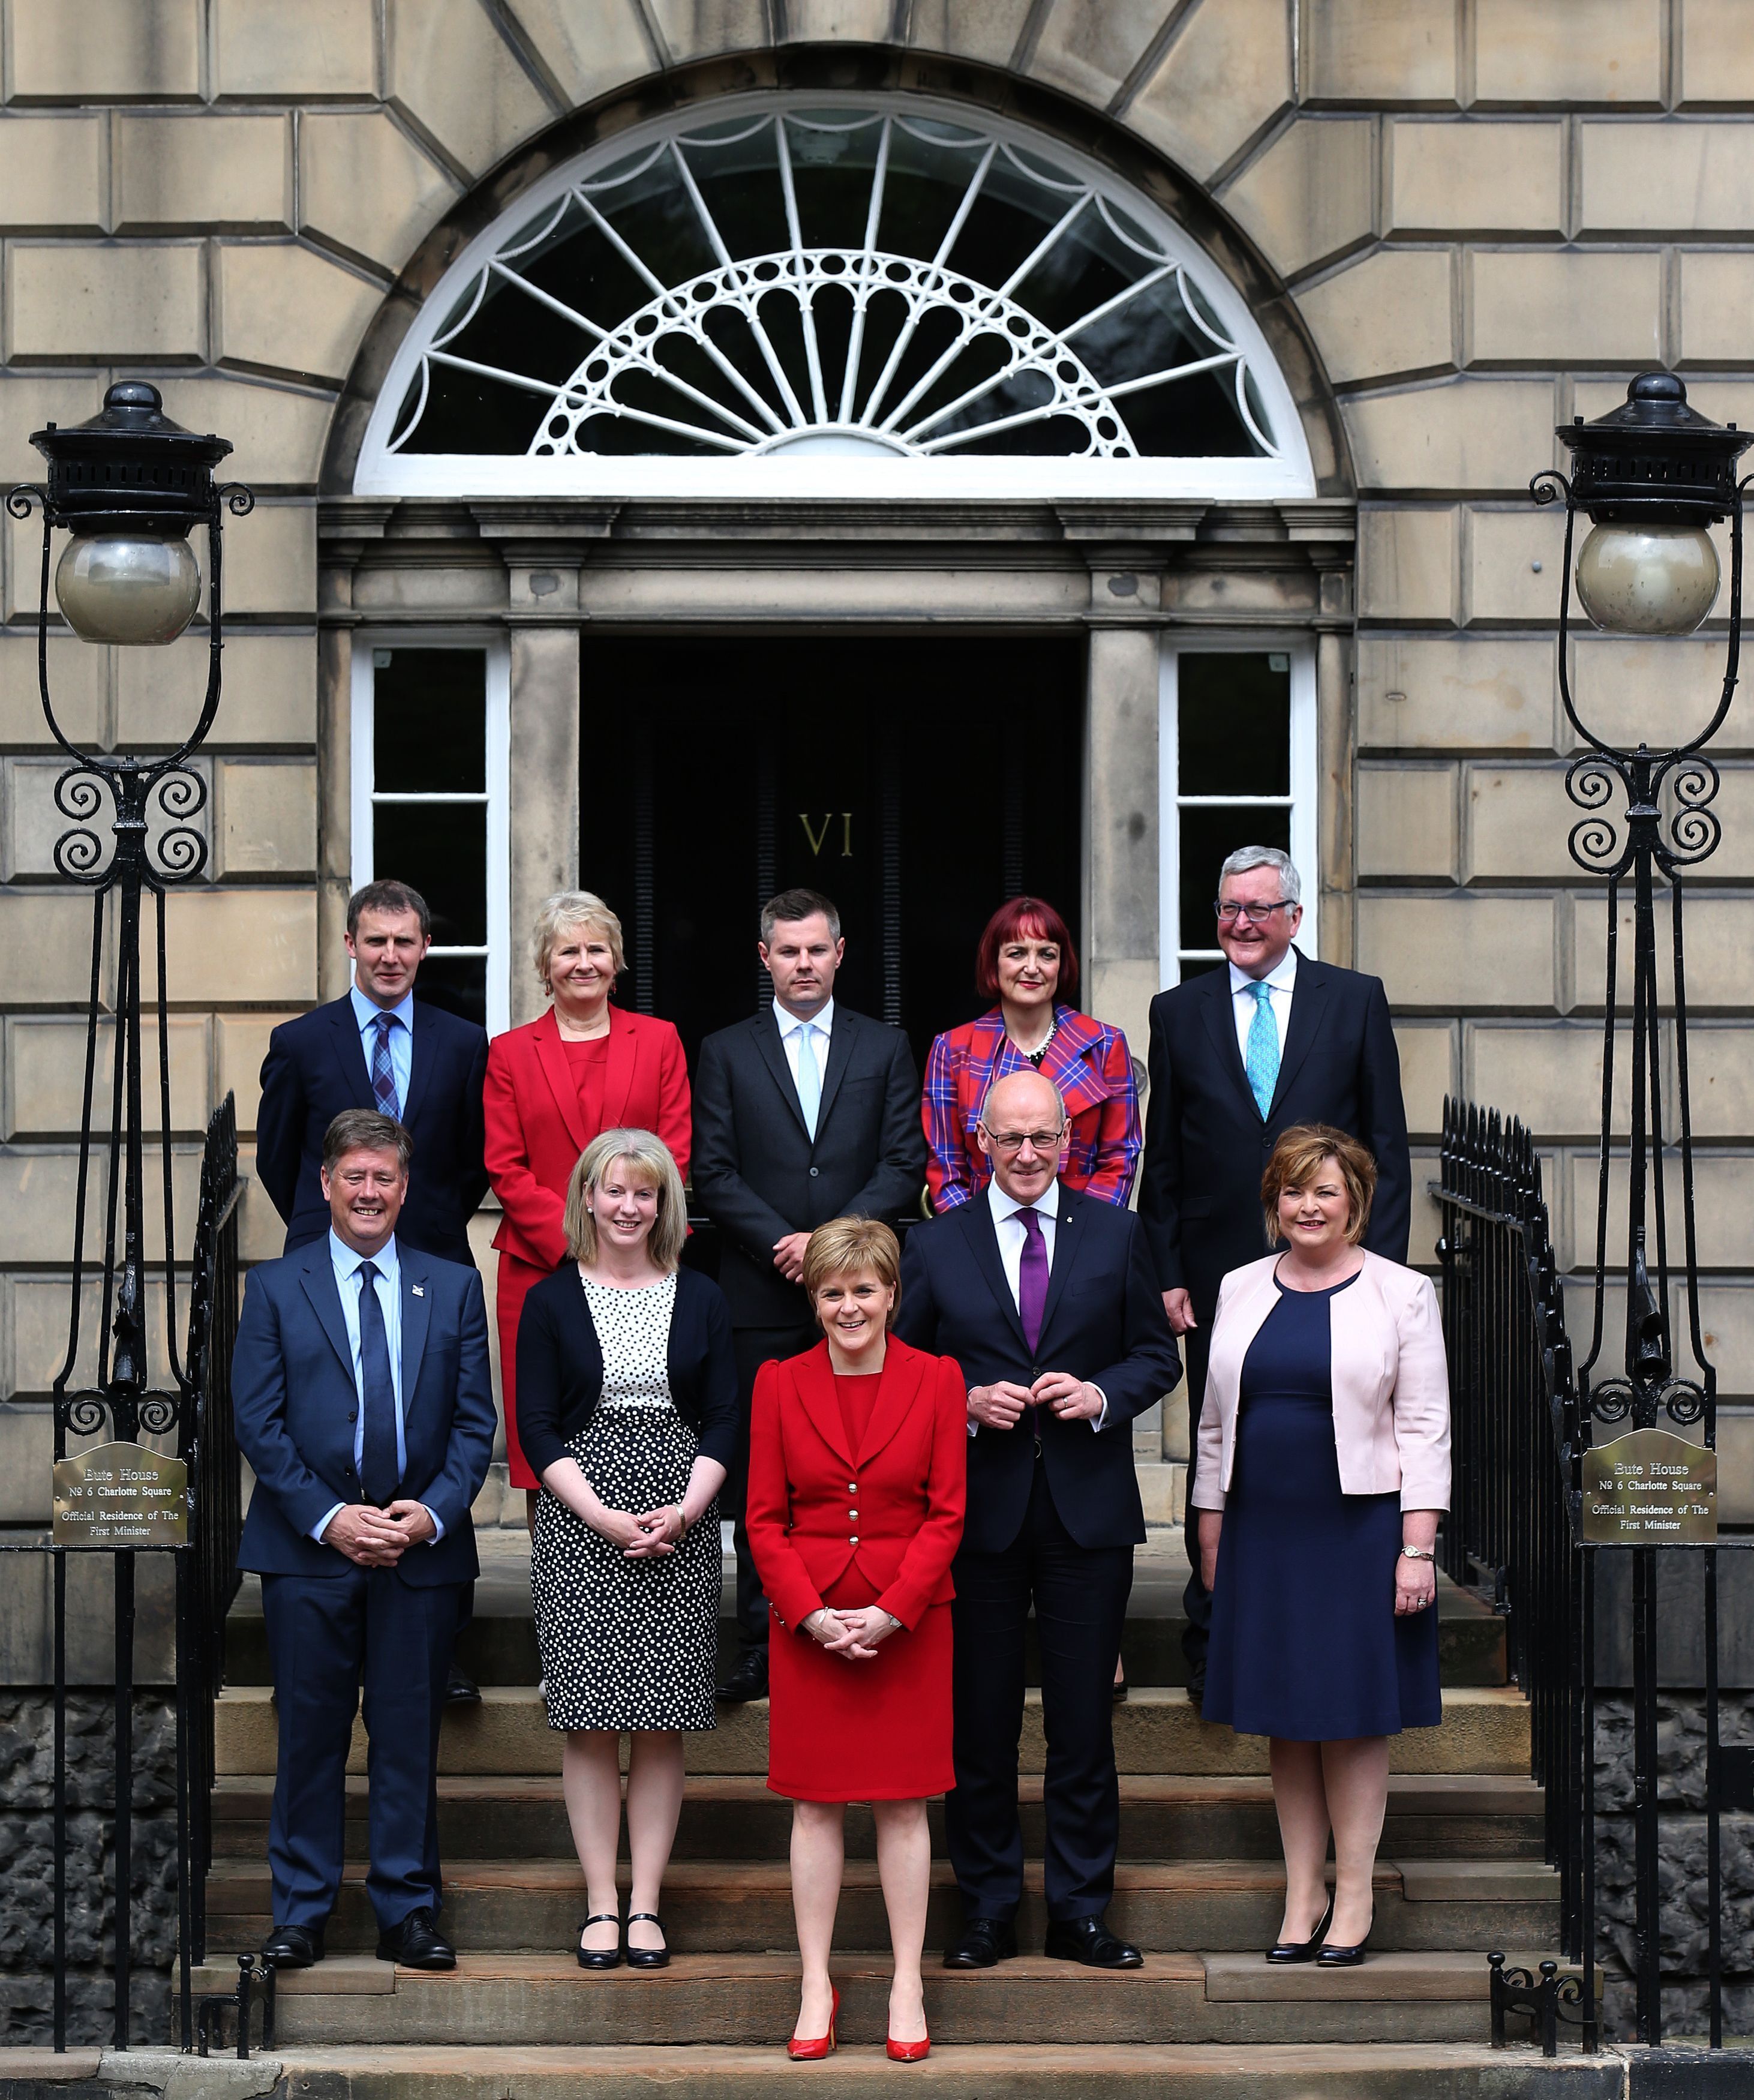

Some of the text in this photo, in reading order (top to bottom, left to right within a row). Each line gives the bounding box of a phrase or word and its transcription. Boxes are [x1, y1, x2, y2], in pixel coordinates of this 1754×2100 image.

[798, 813, 852, 856] VI
[1614, 1463, 1689, 1475] Bute House
[84, 1469, 158, 1481] Bute House
[1617, 1481, 1623, 1490] 6
[1627, 1481, 1667, 1490] Charlotte
[1672, 1481, 1702, 1492] Square
[87, 1487, 93, 1496] 6
[97, 1487, 137, 1496] Charlotte
[142, 1487, 172, 1498] Square
[1592, 1505, 1709, 1514] Official Residence of The
[62, 1511, 179, 1520] Official Residence of The
[1620, 1520, 1681, 1529] First Minister
[90, 1526, 151, 1536] First Minister
